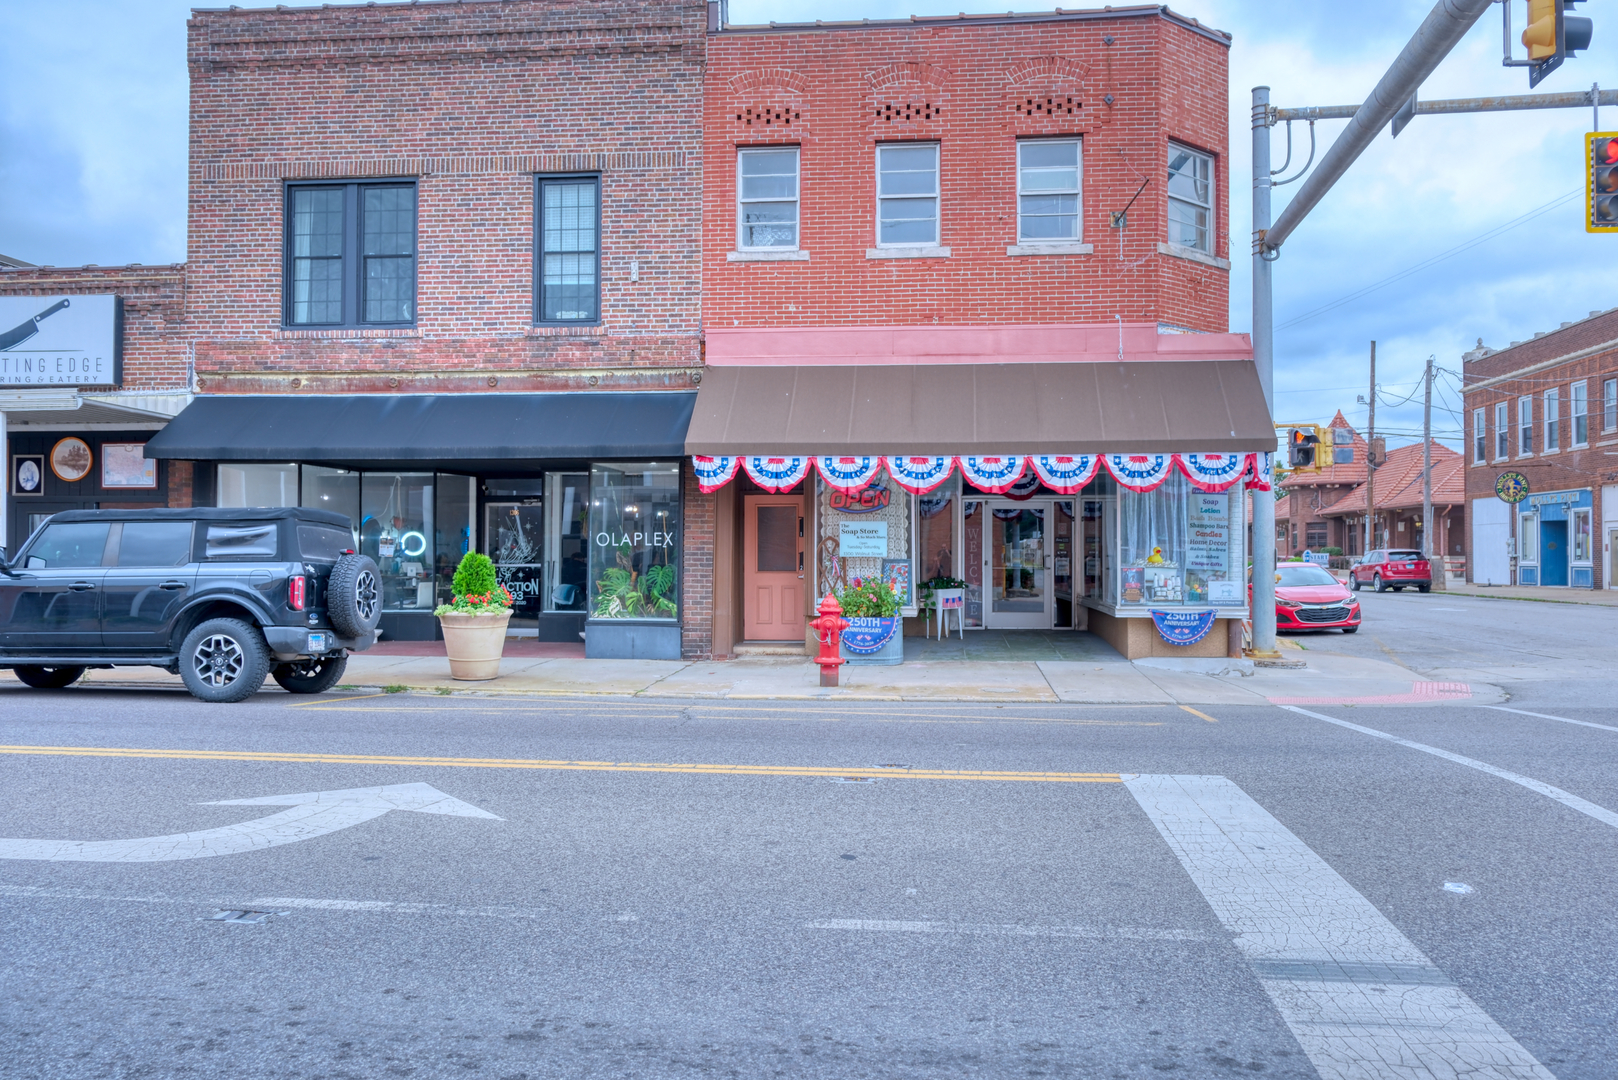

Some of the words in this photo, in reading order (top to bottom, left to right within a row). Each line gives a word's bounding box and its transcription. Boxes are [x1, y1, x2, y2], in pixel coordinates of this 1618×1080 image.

[2, 358, 46, 373] TING
[56, 357, 102, 373] EDGE
[830, 490, 890, 508] OPEN
[1202, 498, 1219, 506] Soap
[1189, 522, 1215, 530] Shampoo
[841, 528, 858, 536] Soap
[1195, 530, 1222, 538] Candles
[596, 532, 674, 547] OLAPLEX
[967, 528, 980, 616] WELCME
[847, 617, 880, 627] 250TH
